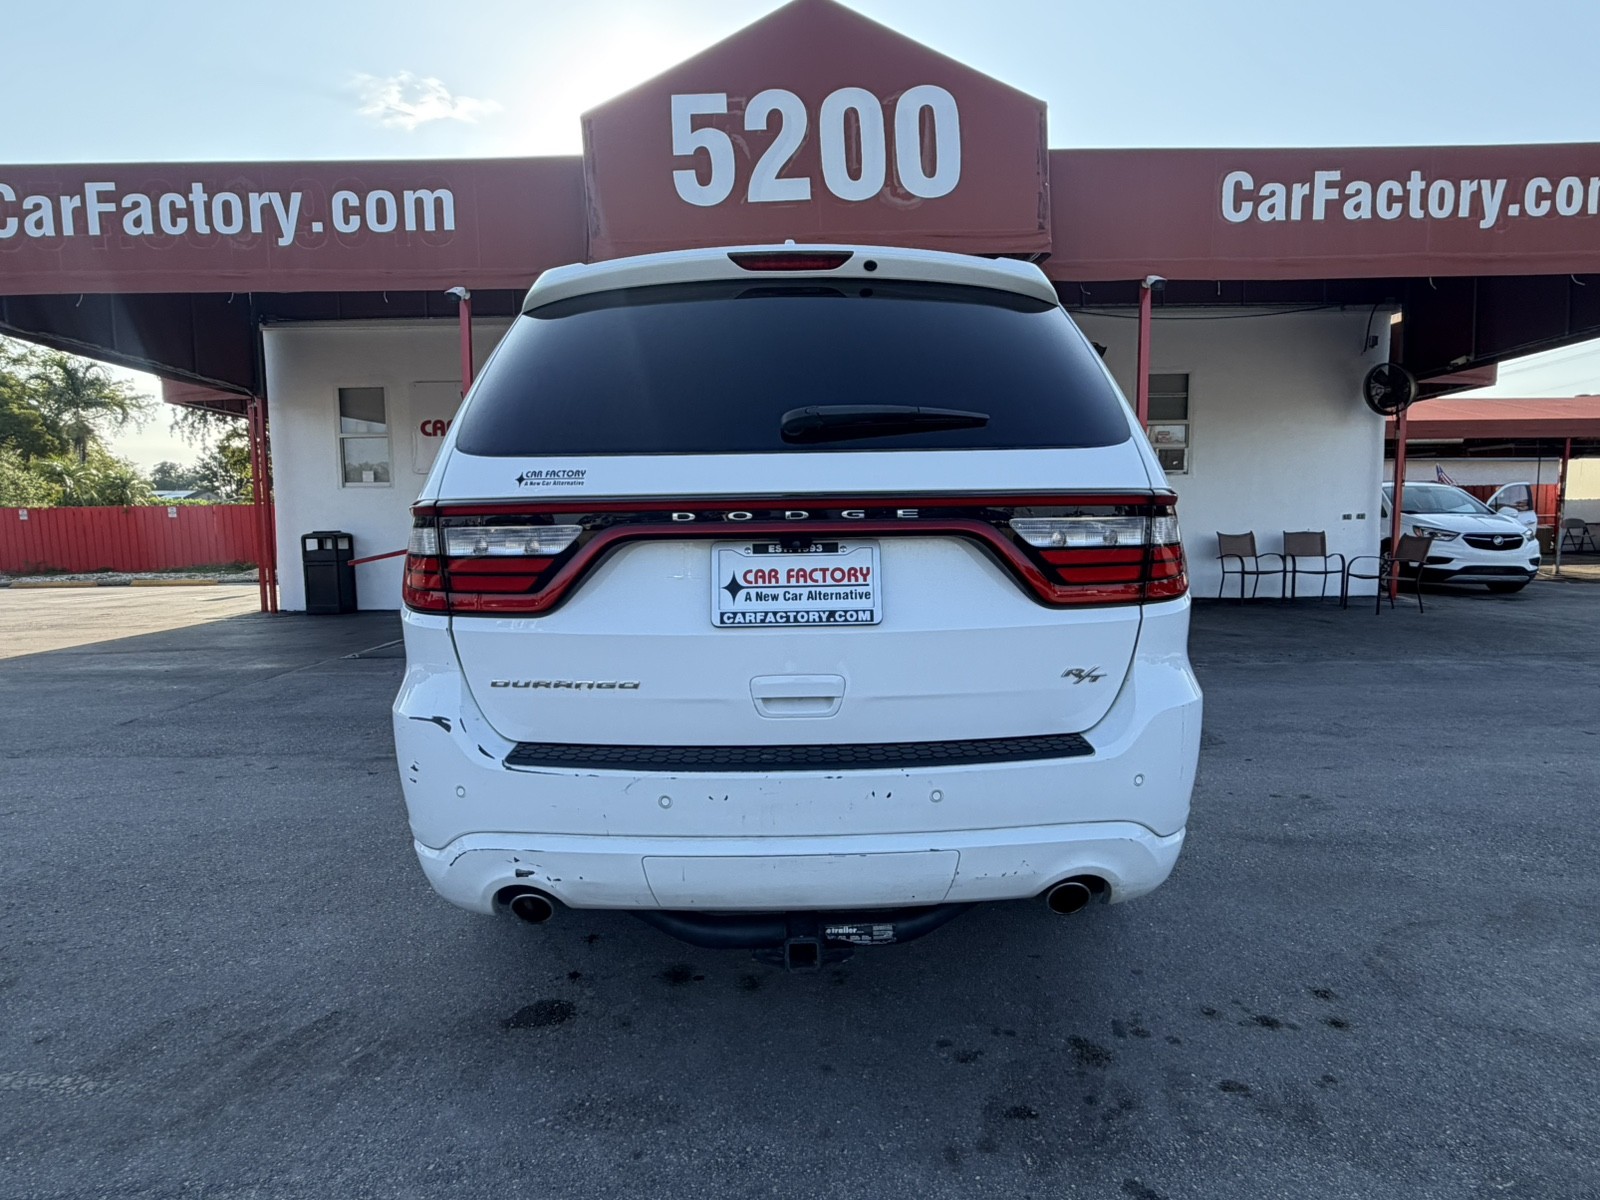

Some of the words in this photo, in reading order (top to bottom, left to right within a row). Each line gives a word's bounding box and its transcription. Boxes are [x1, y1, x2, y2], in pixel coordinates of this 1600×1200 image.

[670, 84, 962, 207] 5200
[1221, 169, 1600, 229] CarFactory.co
[525, 470, 543, 478] CAR
[545, 469, 587, 478] FACTORY
[671, 509, 919, 522] DODGE
[742, 568, 780, 585] CAR
[786, 566, 871, 584] FACTORY
[744, 592, 752, 602] A
[755, 591, 780, 602] New
[783, 590, 803, 602] Car
[806, 589, 871, 601] Alternative
[723, 610, 871, 624] CARFACTORY.COM
[490, 679, 640, 690] DURANGO
